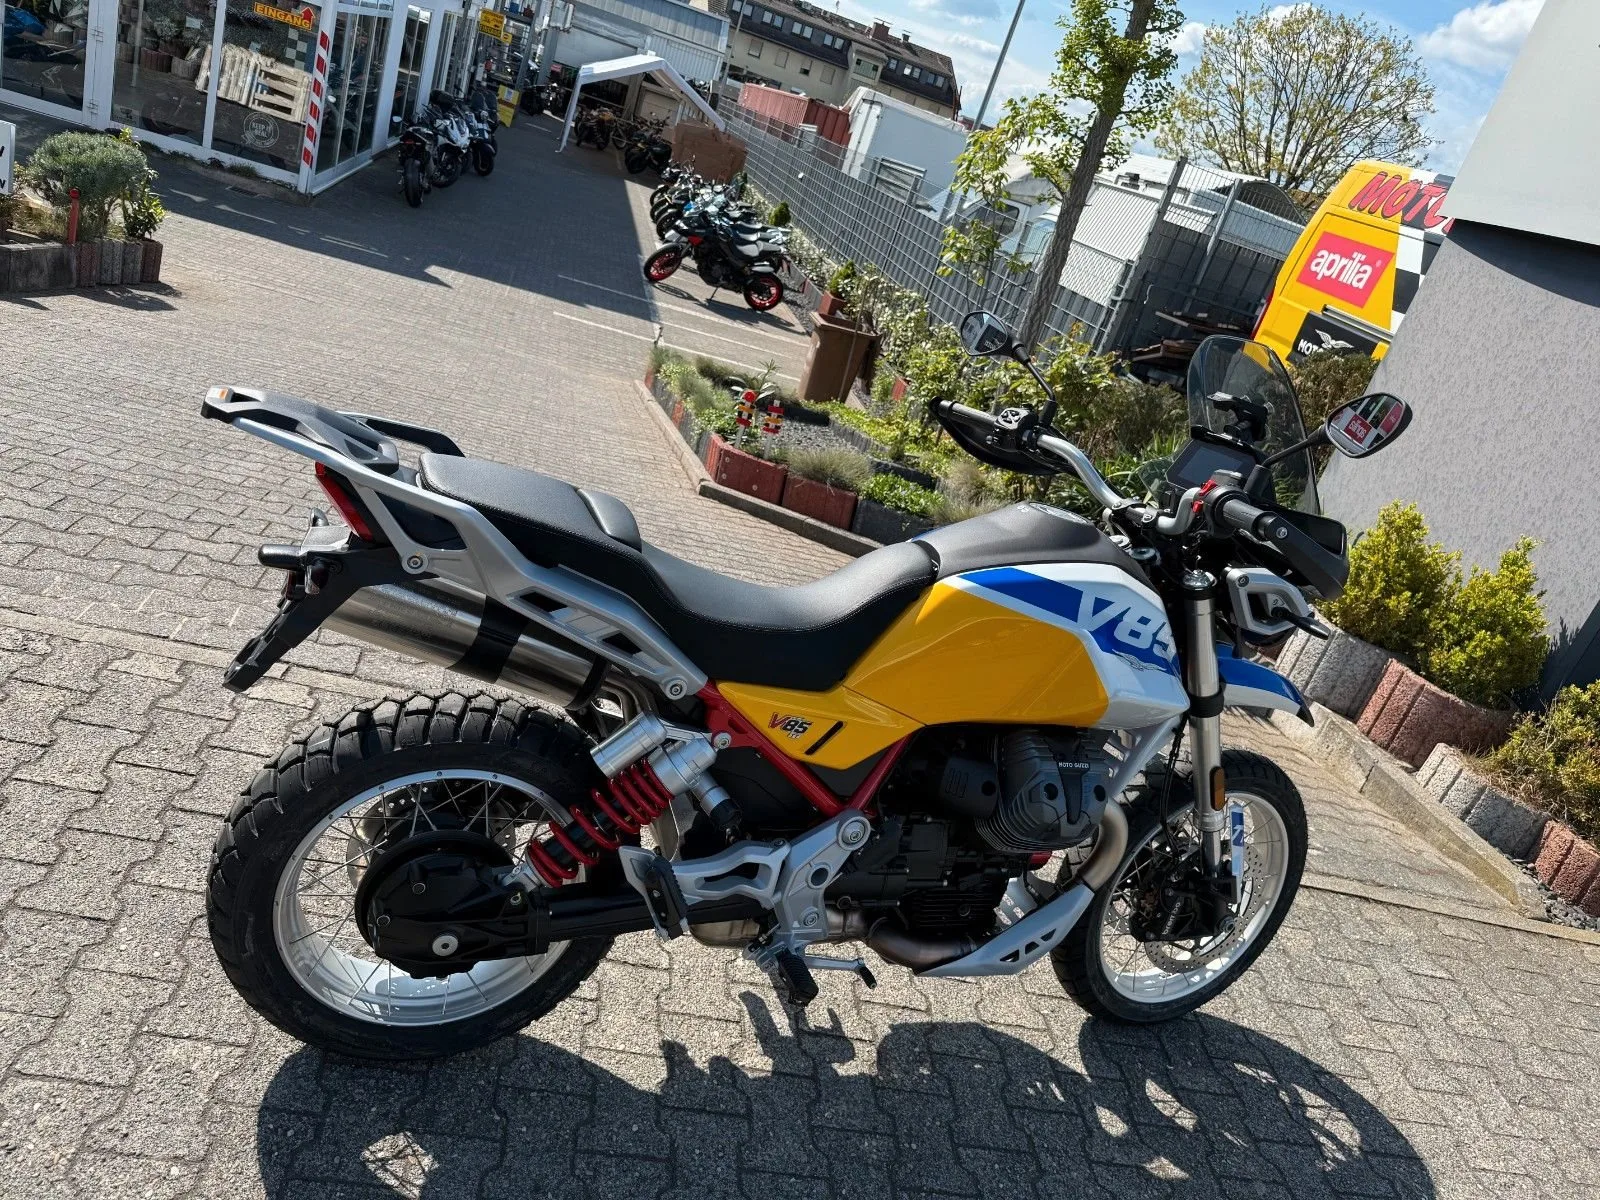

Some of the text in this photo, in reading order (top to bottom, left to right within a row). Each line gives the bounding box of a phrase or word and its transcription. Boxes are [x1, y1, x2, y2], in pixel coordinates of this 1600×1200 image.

[256, 4, 311, 28] EINGANG
[1310, 250, 1373, 289] aprilia
[1077, 590, 1177, 663] V85
[768, 712, 813, 734] V85
[1162, 902, 1181, 935] brembo
